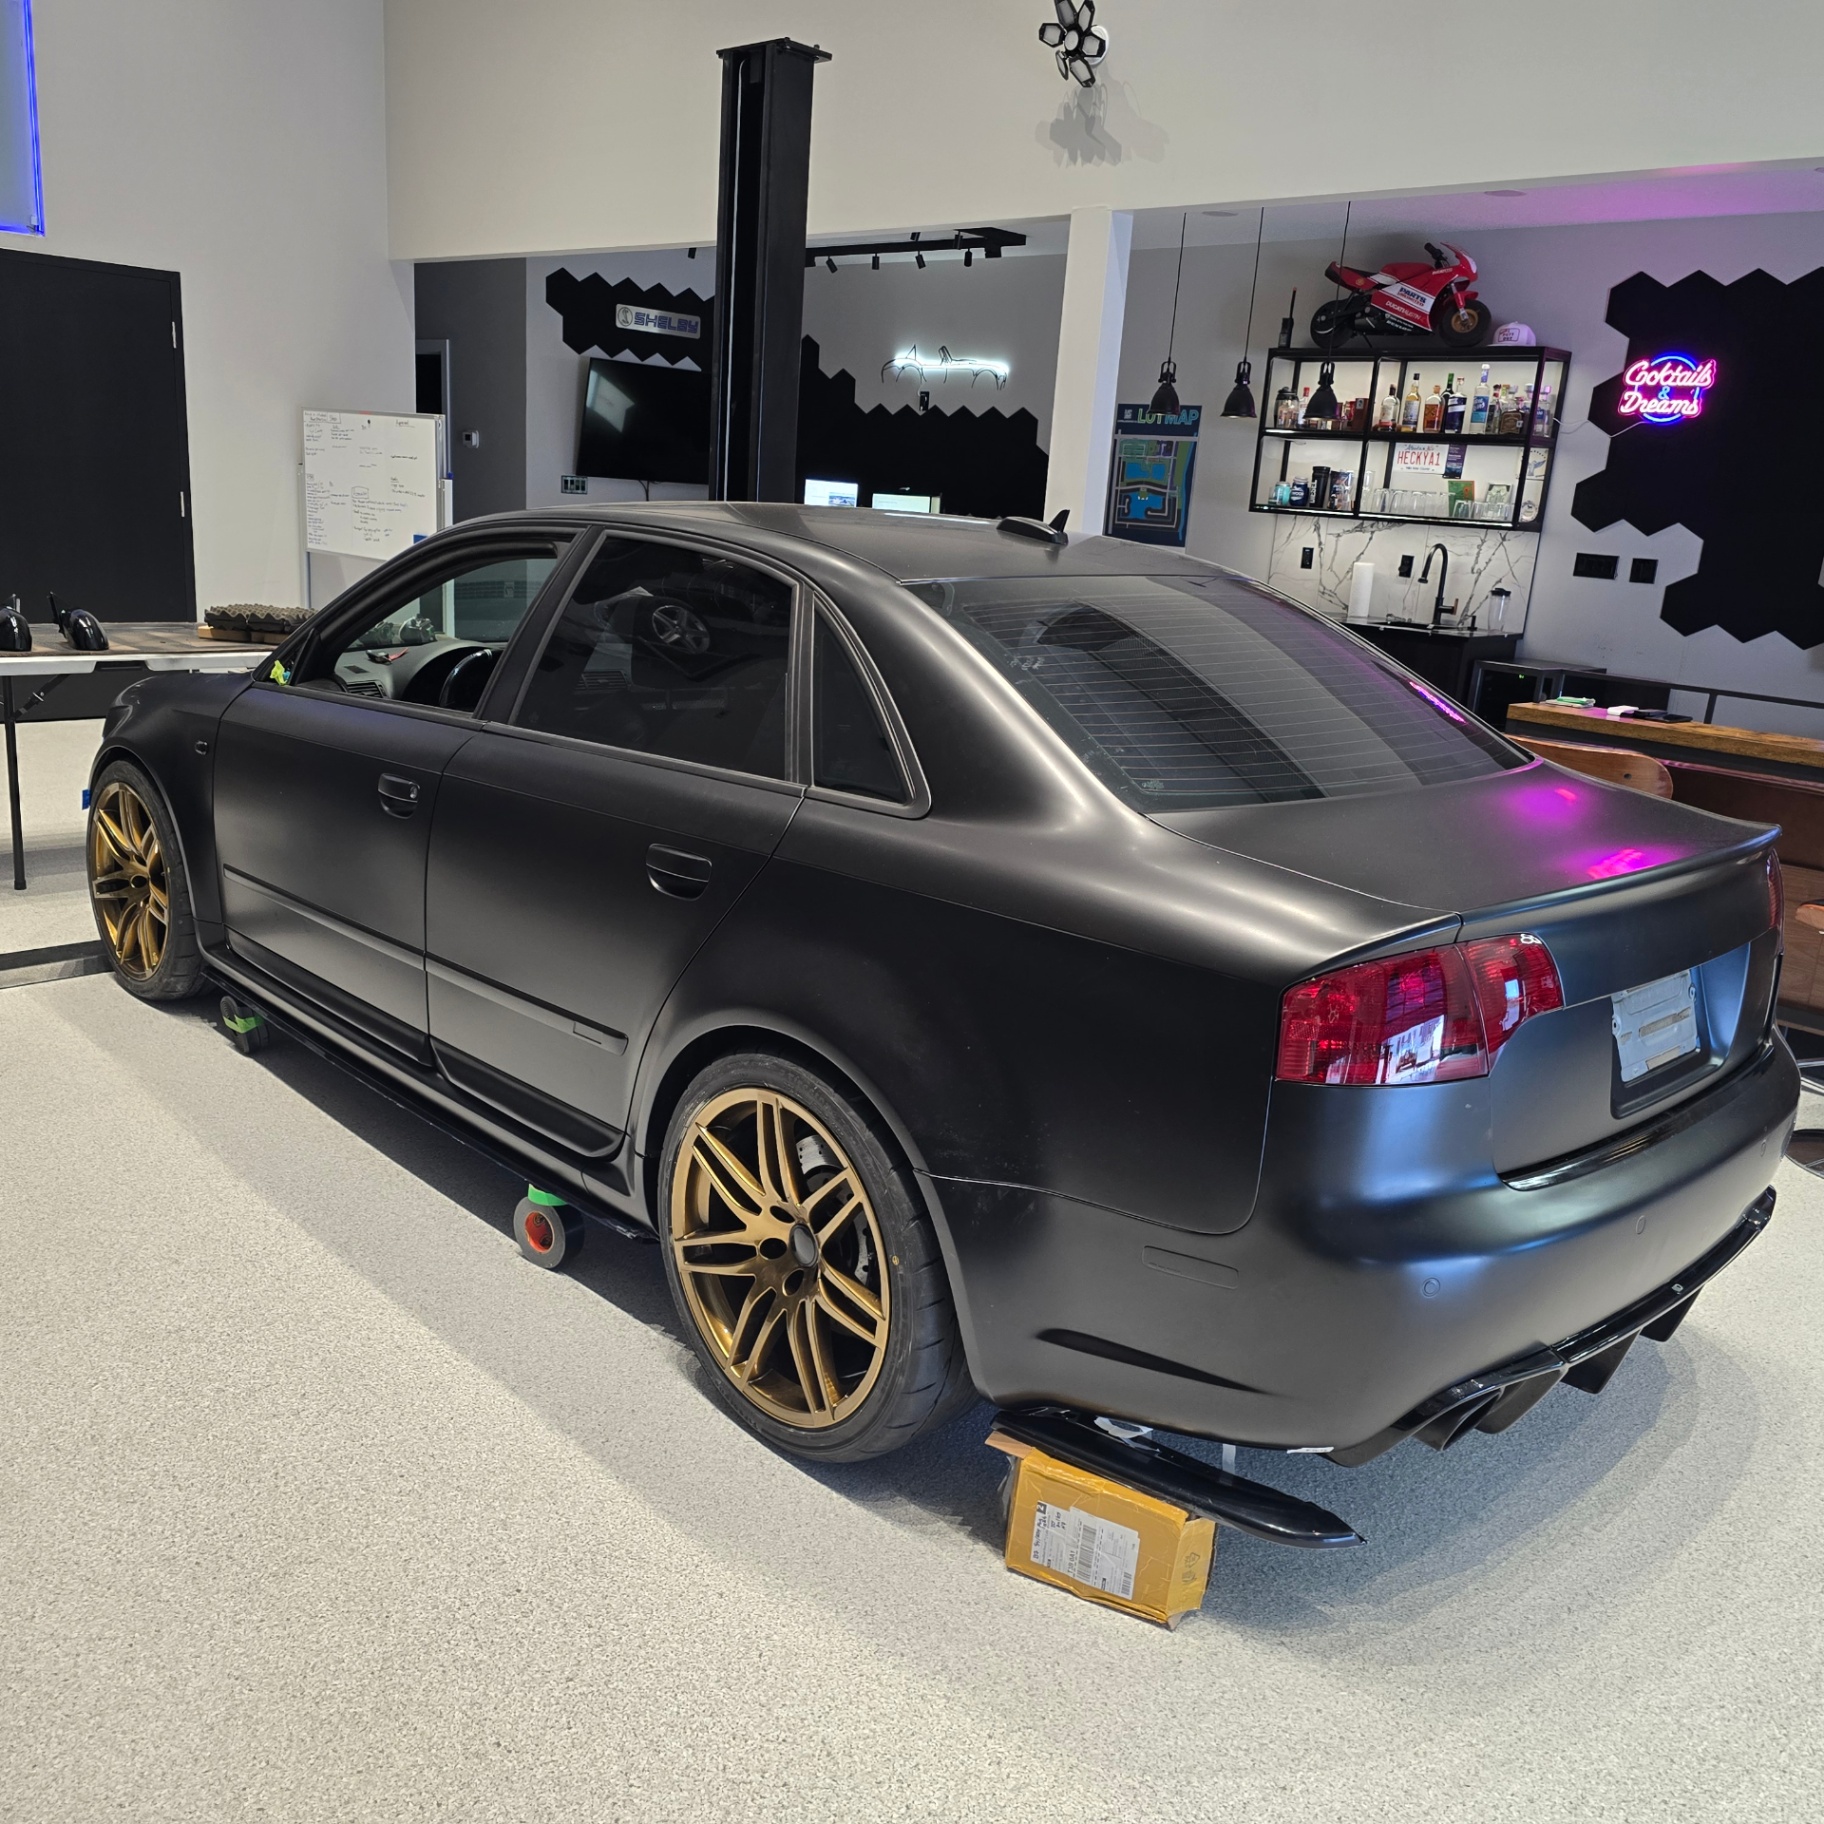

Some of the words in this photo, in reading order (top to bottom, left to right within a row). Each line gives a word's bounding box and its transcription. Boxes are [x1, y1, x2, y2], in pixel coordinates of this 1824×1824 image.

[1400, 287, 1427, 304] PARTS
[1385, 300, 1405, 314] DUCATI
[634, 311, 699, 334] SHELBY
[1625, 360, 1713, 387] Cocktails
[1658, 386, 1670, 400] &
[1620, 391, 1699, 415] Dreams
[1138, 408, 1162, 424] LOT
[1165, 409, 1199, 425] MAP
[1397, 451, 1440, 466] HECKYA1
